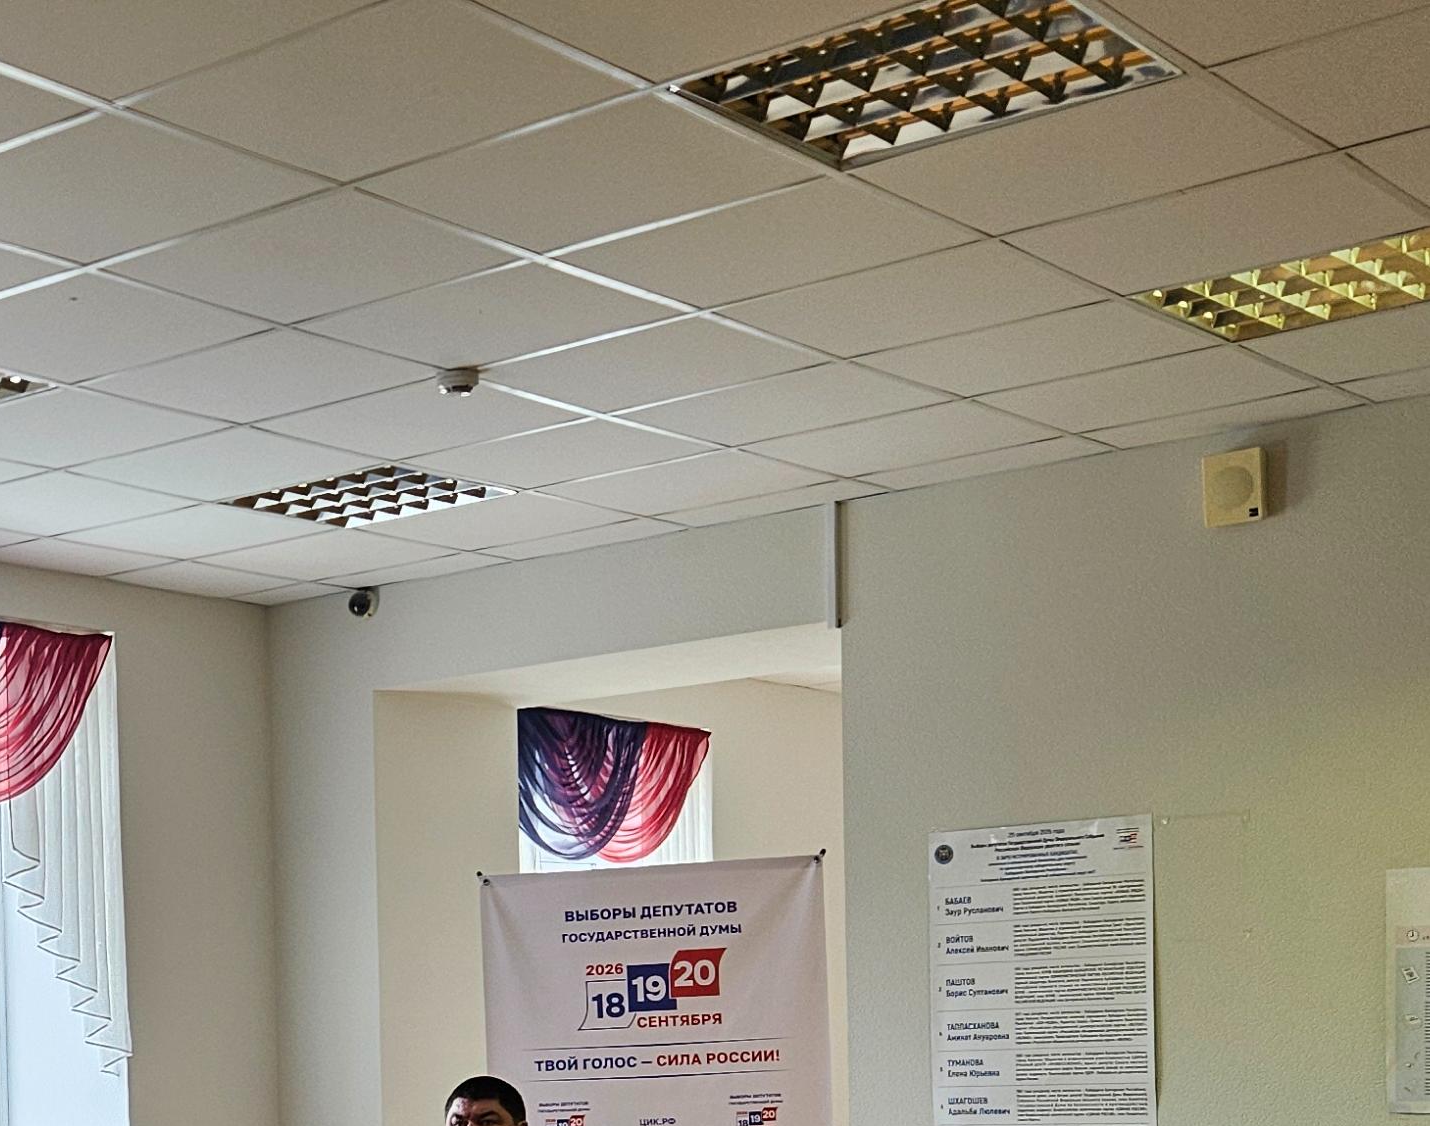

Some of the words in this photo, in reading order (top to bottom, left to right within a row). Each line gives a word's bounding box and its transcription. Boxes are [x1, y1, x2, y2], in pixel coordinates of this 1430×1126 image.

[565, 907, 636, 922] ВЫБОРЫ
[640, 901, 737, 919] ДЕПУТАТОВ
[562, 924, 696, 943] ГОСУДАРСТВЕННОЙ
[699, 924, 742, 937] ДУМЫ
[586, 963, 624, 976] 2026
[591, 992, 625, 1018] 18
[631, 975, 666, 1003] 19
[674, 959, 716, 987] 20
[637, 1013, 722, 1028] СЕНТЯБРЯ
[534, 1056, 578, 1072] ТВОЙ
[583, 1056, 637, 1070] ГОЛОС
[656, 1053, 701, 1067] СИЛА
[706, 1050, 780, 1065] РОССИИ!
[639, 1117, 676, 1126] ЦИК.РФ
[762, 1110, 775, 1118] 20
[570, 1118, 582, 1126] 20
